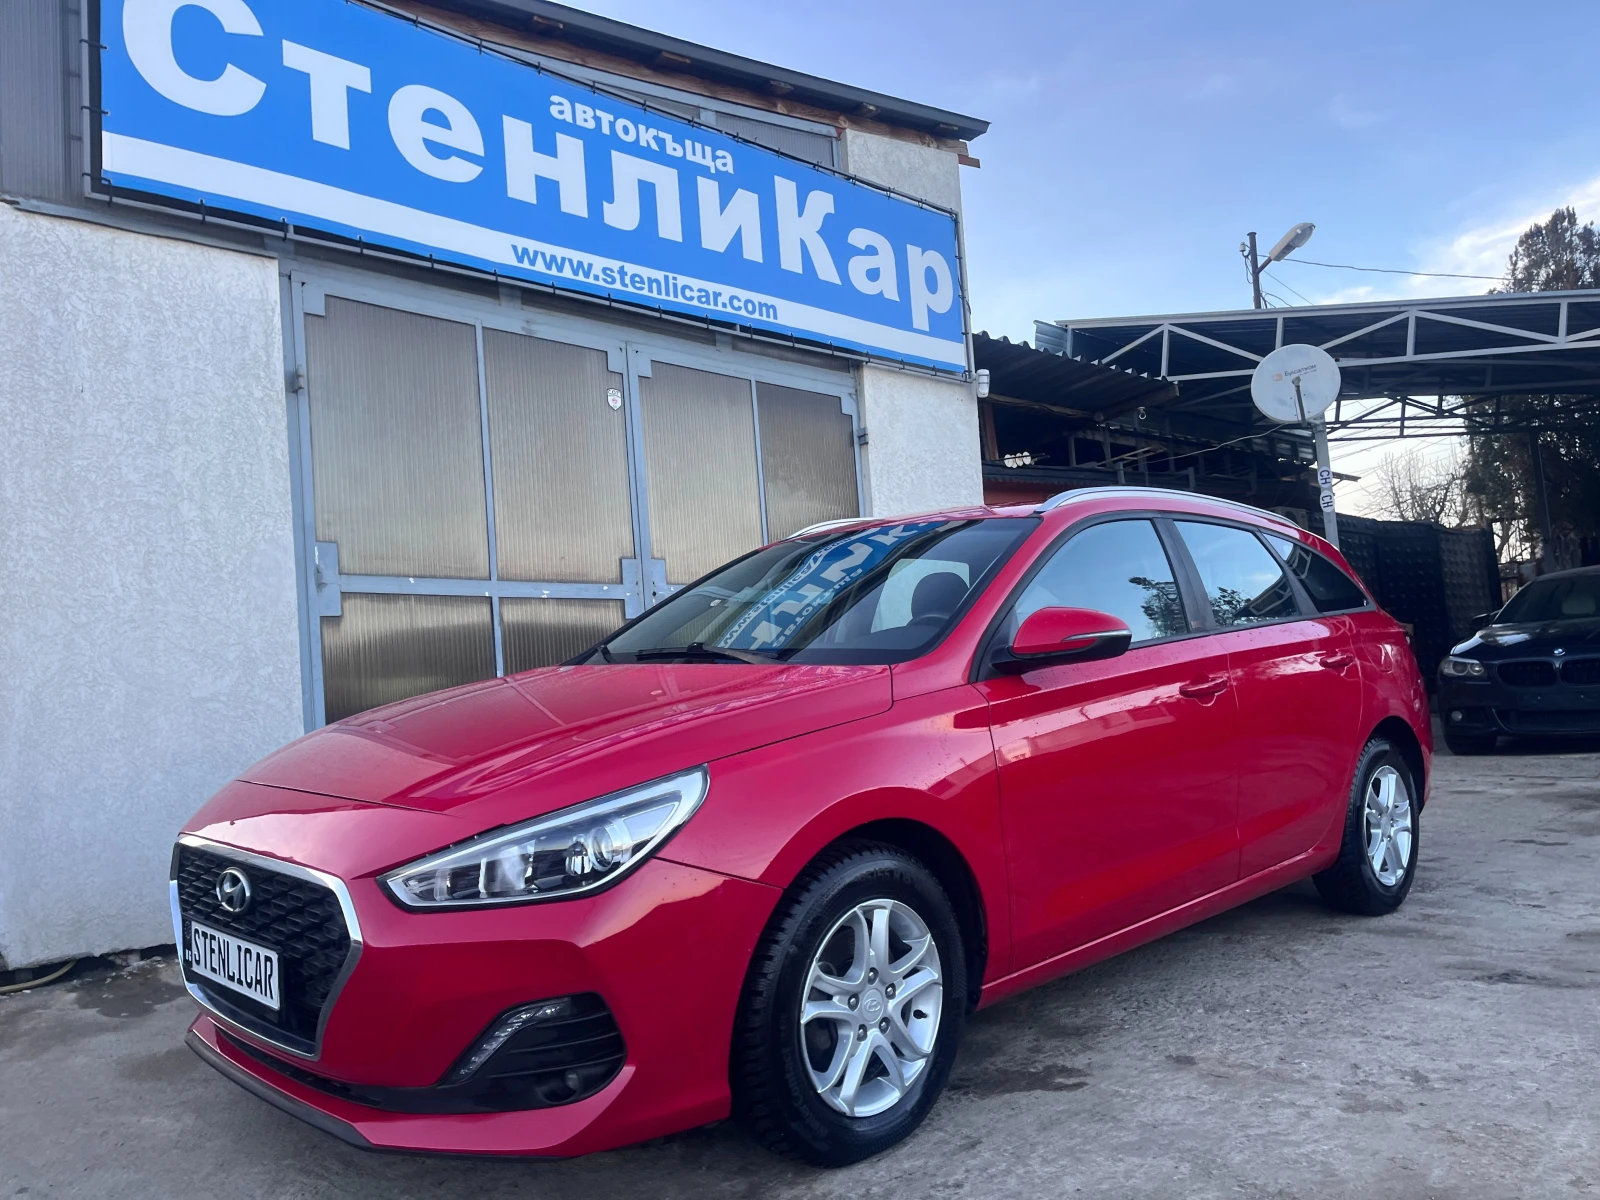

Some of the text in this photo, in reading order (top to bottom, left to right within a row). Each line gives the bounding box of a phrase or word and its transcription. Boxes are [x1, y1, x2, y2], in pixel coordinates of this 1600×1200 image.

[122, 0, 954, 332] СтенлиКар
[550, 95, 734, 174] автокъща
[511, 244, 778, 320] www.stenlicar.com
[1320, 470, 1331, 485] CH
[1321, 495, 1333, 508] CH
[193, 928, 274, 1000] STENLICAR
